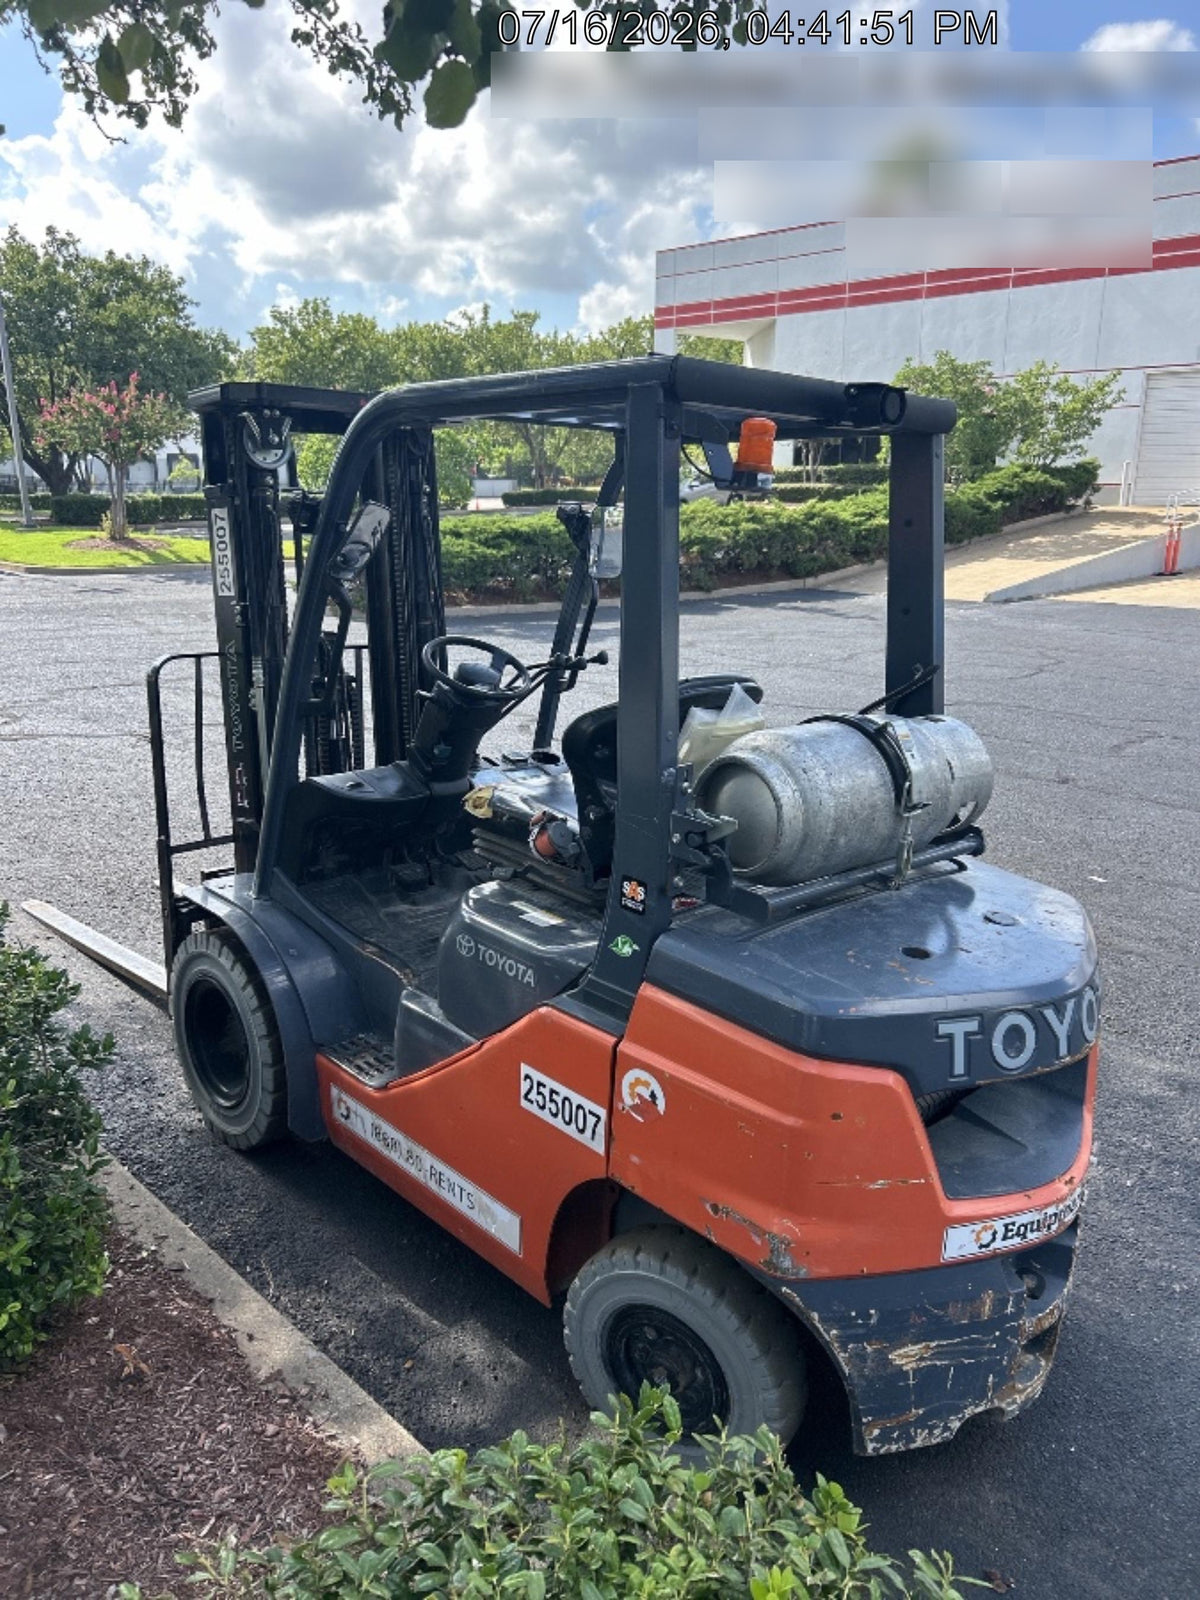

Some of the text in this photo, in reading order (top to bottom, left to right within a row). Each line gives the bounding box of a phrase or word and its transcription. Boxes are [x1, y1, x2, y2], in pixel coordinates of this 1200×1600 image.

[214, 512, 233, 594] 255007
[225, 639, 244, 752] TOYOTA
[477, 943, 536, 988] TOYOTA
[522, 1072, 602, 1142] 255007
